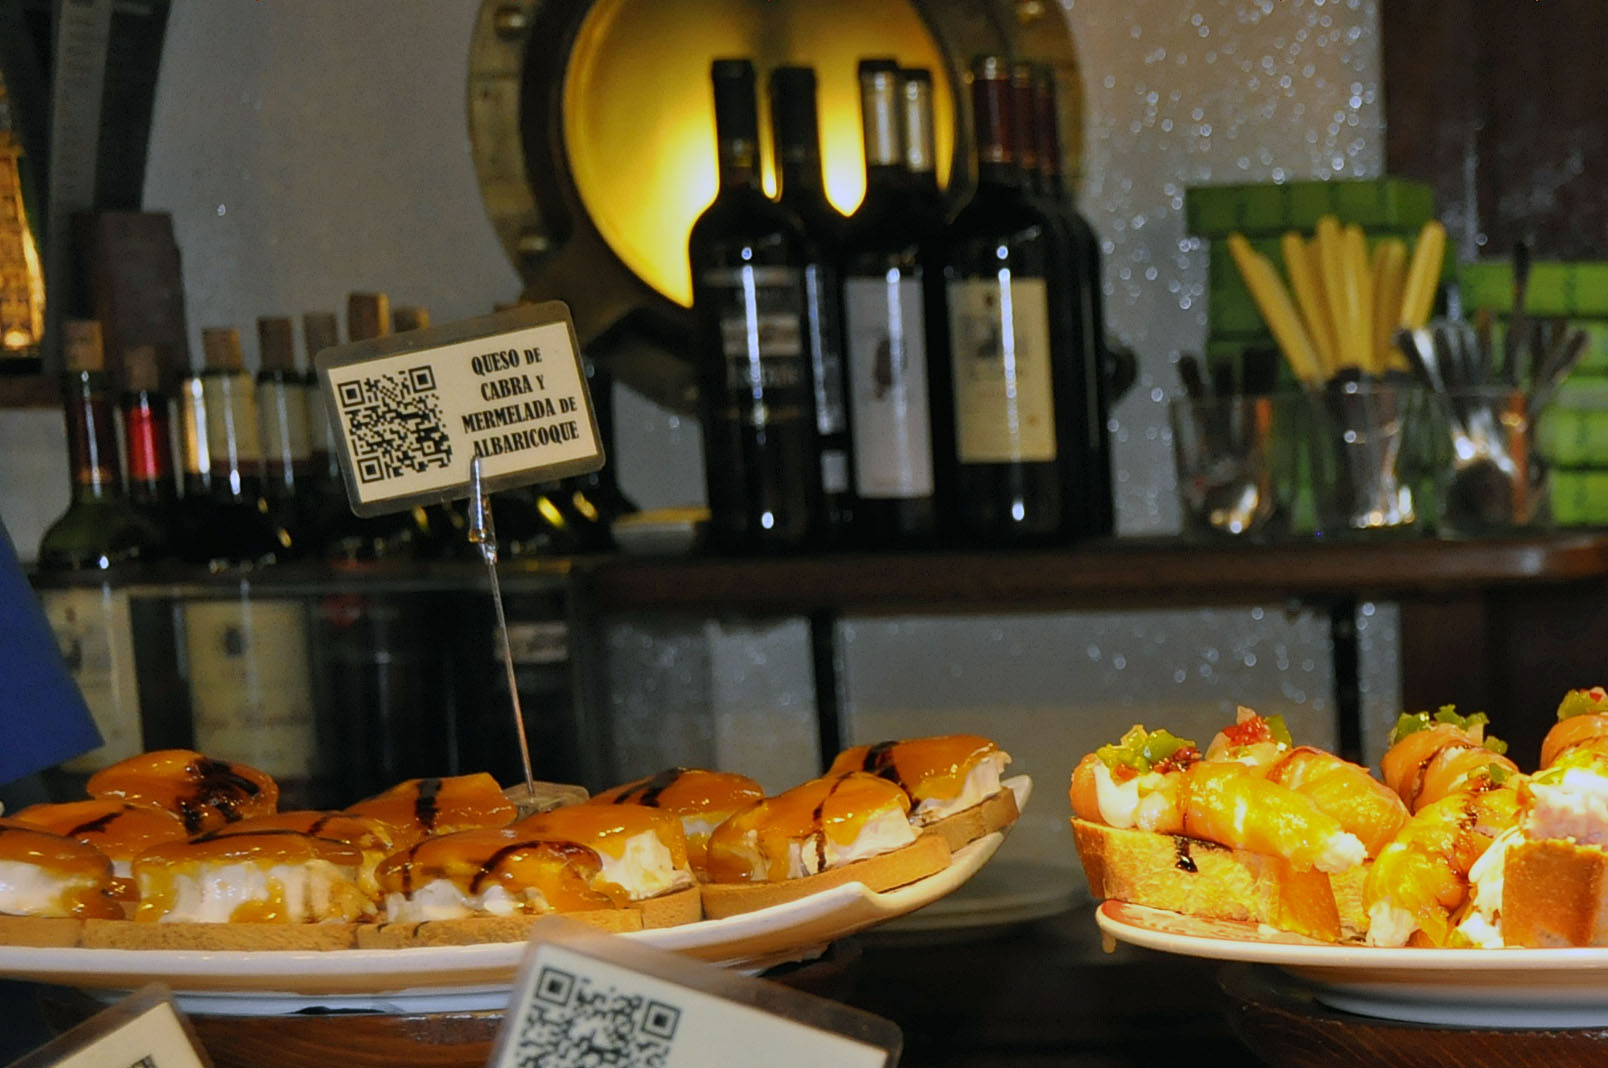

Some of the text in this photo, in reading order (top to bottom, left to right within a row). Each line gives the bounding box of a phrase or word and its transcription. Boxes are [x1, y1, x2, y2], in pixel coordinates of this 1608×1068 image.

[471, 347, 542, 376] QUESO DE
[481, 374, 545, 402] CABRA Y
[461, 396, 578, 434] MERMELADA DE
[473, 420, 579, 459] ALBARICOQUE
